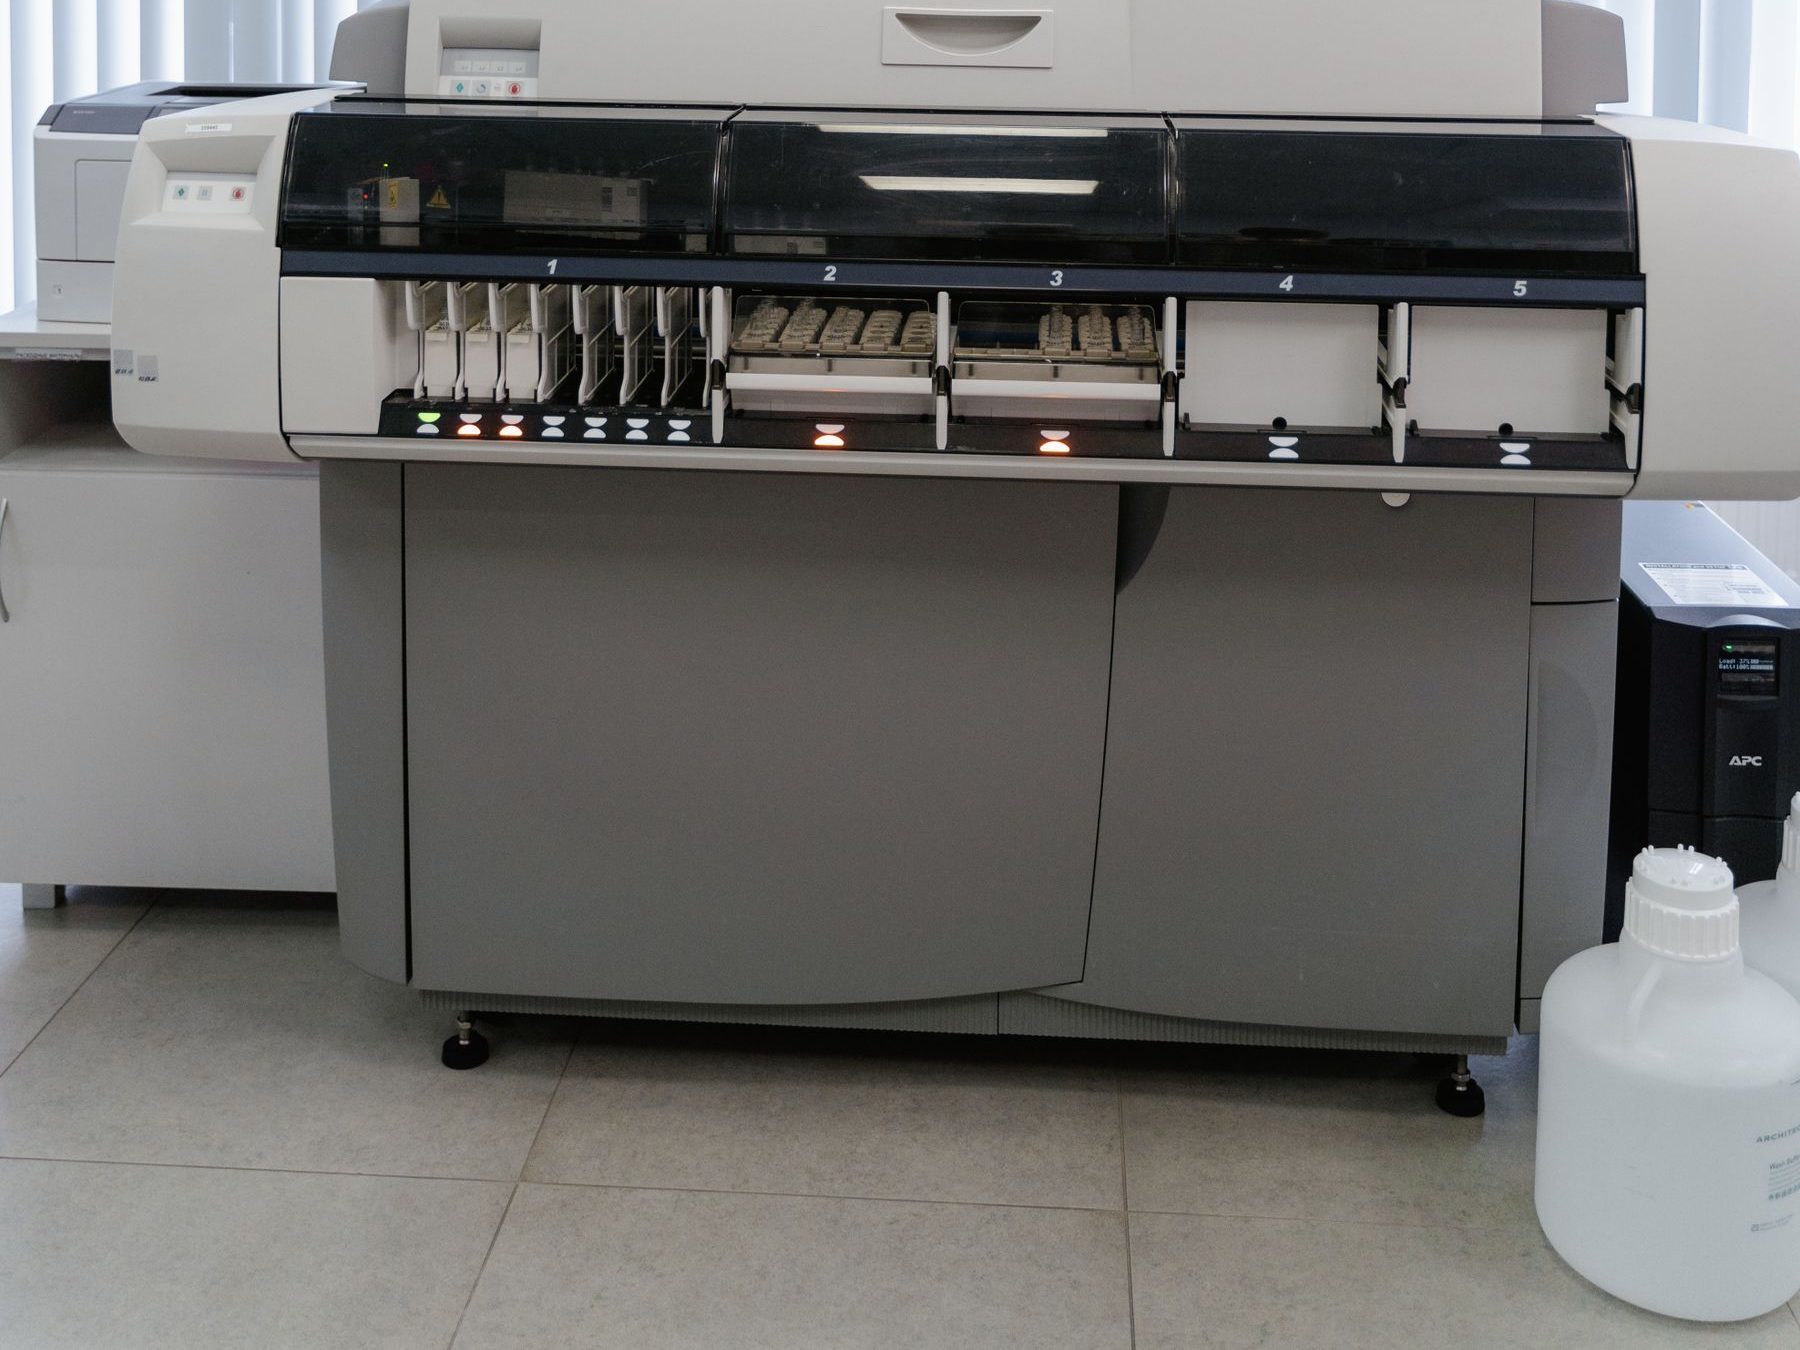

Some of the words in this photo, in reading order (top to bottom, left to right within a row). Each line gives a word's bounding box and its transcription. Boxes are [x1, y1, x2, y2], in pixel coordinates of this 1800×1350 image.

[546, 258, 558, 275] 1
[823, 264, 837, 282] 2
[1049, 269, 1064, 287] 3
[1278, 275, 1294, 292] 4
[1512, 280, 1528, 298] 5
[1728, 755, 1763, 767] APC
